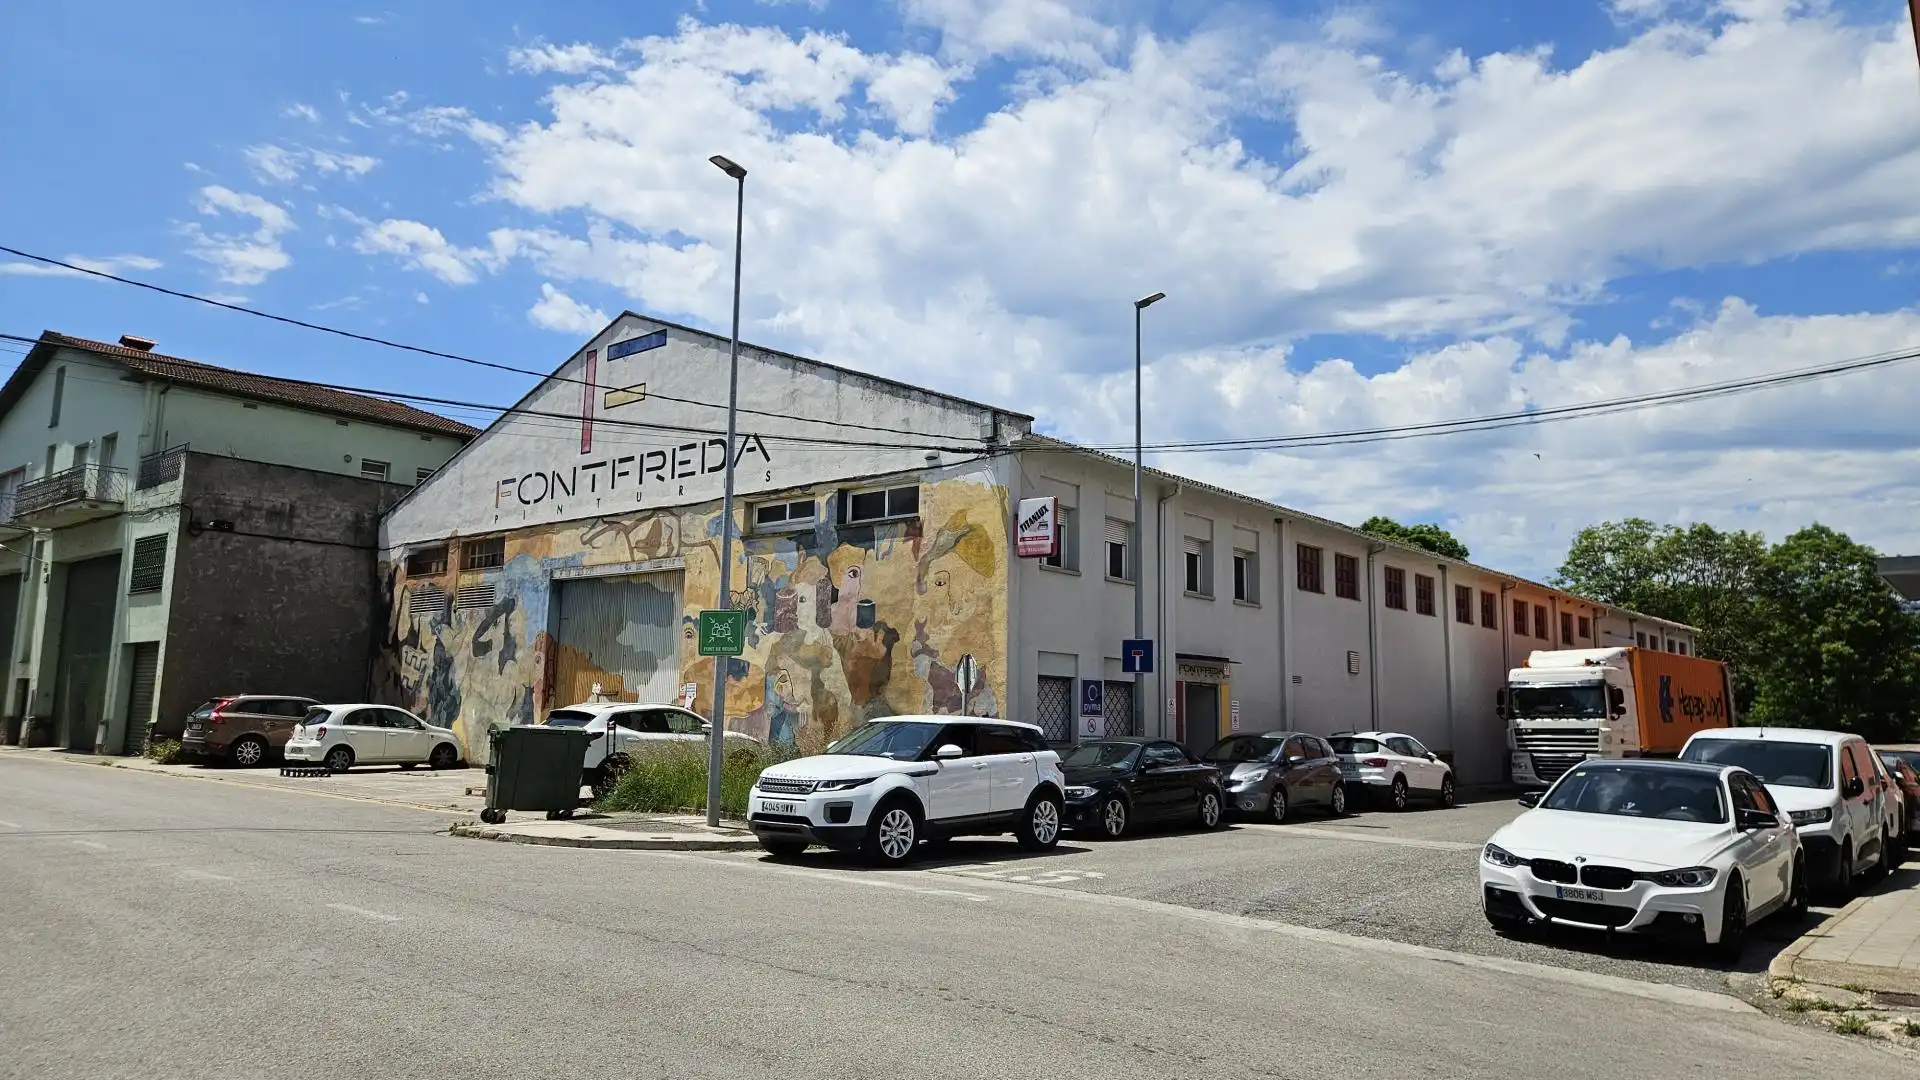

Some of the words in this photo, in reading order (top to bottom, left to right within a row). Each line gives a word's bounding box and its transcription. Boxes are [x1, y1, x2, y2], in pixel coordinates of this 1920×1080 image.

[496, 433, 771, 508] FONTFREDA
[495, 470, 772, 525] PINTURS
[1020, 504, 1049, 533] TITANLUX
[1083, 703, 1101, 713] pyma
